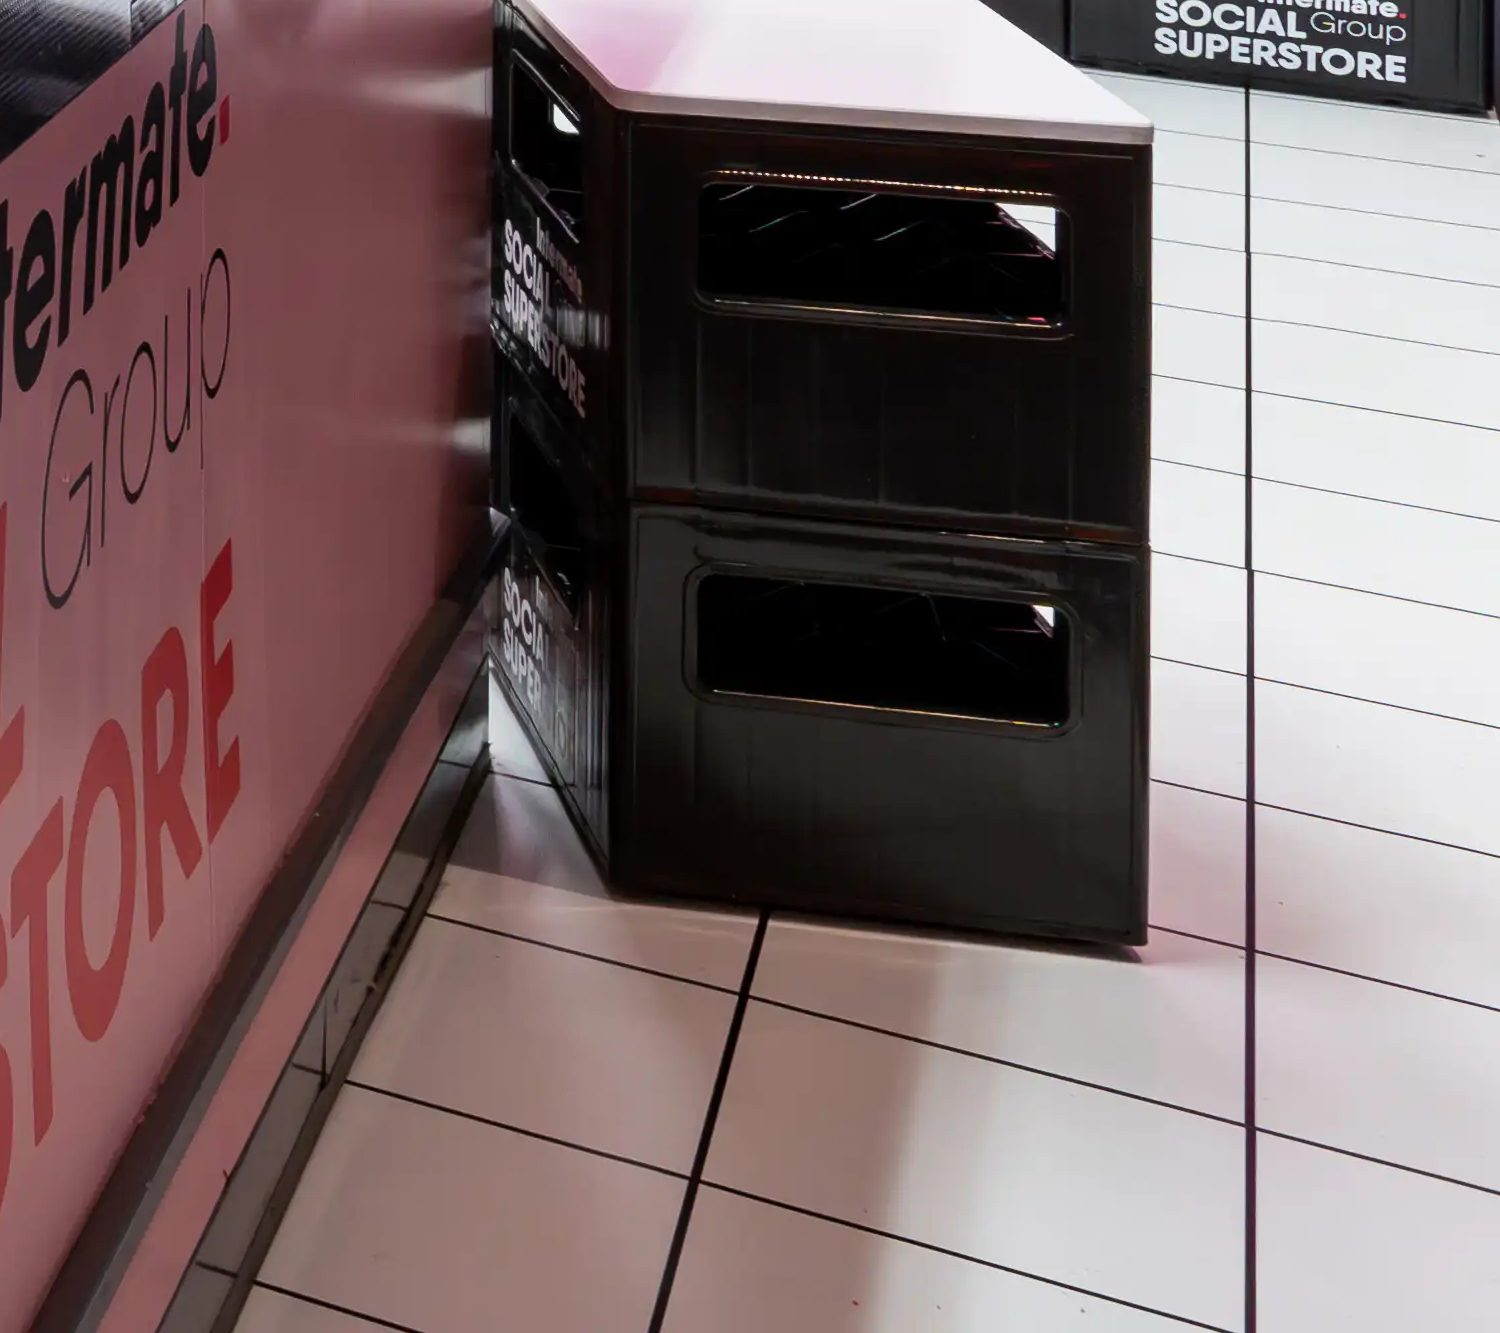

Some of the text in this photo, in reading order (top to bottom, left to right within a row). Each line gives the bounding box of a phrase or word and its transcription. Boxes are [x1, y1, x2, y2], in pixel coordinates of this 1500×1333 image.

[1310, 10, 1406, 45] Group
[1154, 28, 1406, 82] SUPERSTORE
[41, 247, 232, 609] Group
